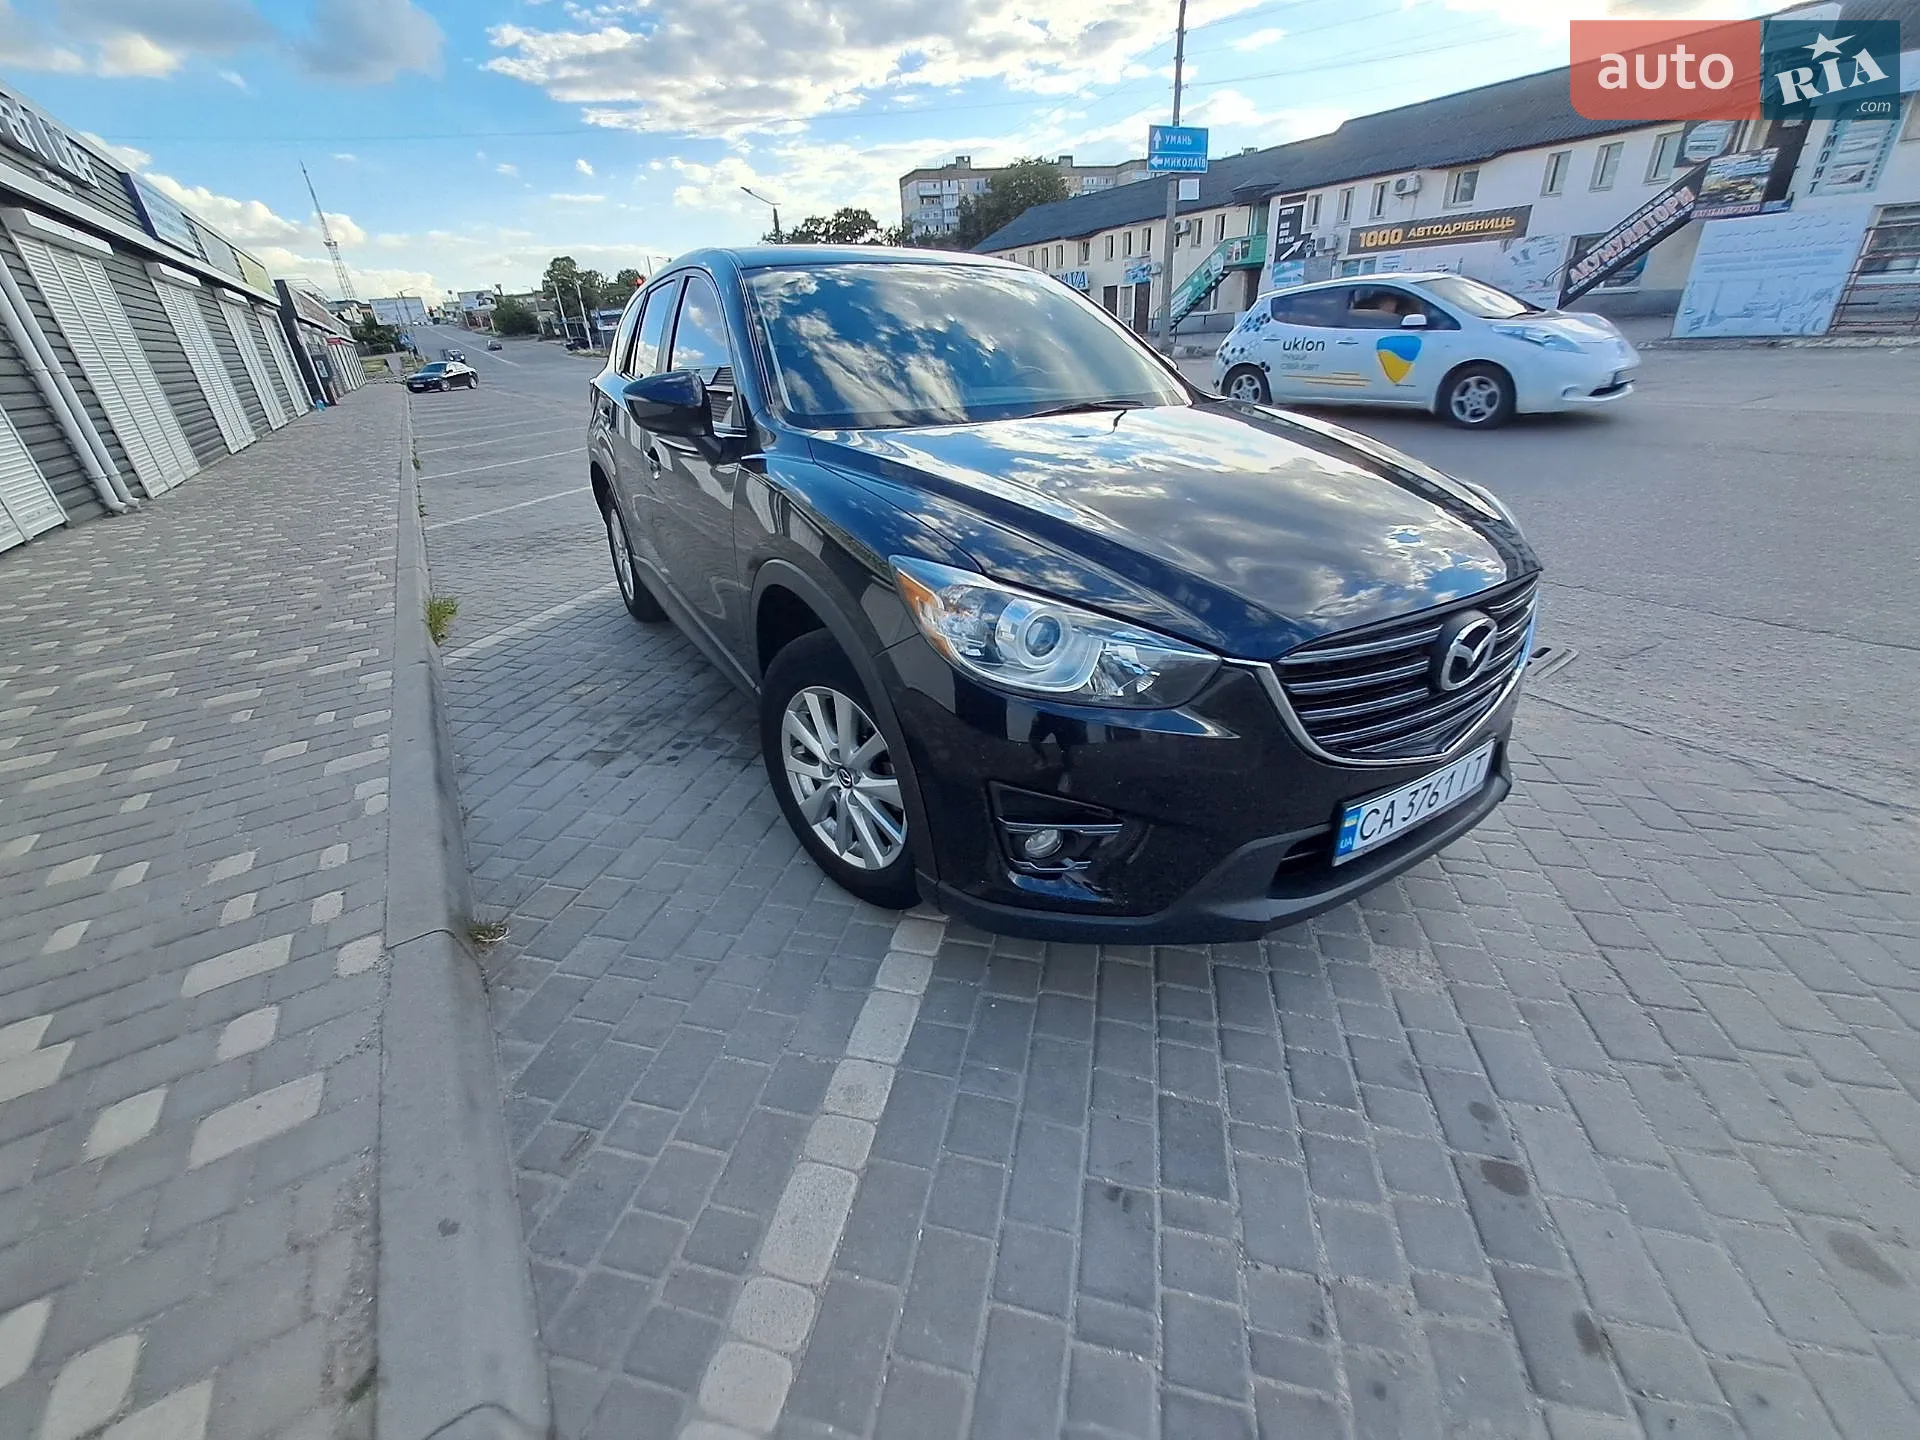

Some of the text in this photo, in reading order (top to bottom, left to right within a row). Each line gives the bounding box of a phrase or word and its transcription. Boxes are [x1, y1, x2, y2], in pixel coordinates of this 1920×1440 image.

[1164, 134, 1192, 145] УМАНЬ
[1163, 156, 1206, 168] МИКОЛАЇВ
[1359, 216, 1516, 248] 1000 АВТОДРІБНИЦЬ
[1569, 186, 1696, 284] АКУМУЛЯТОРИ
[1283, 336, 1325, 351] uklon
[1359, 752, 1488, 841] CA 3761 IT
[1340, 839, 1353, 849] UA
